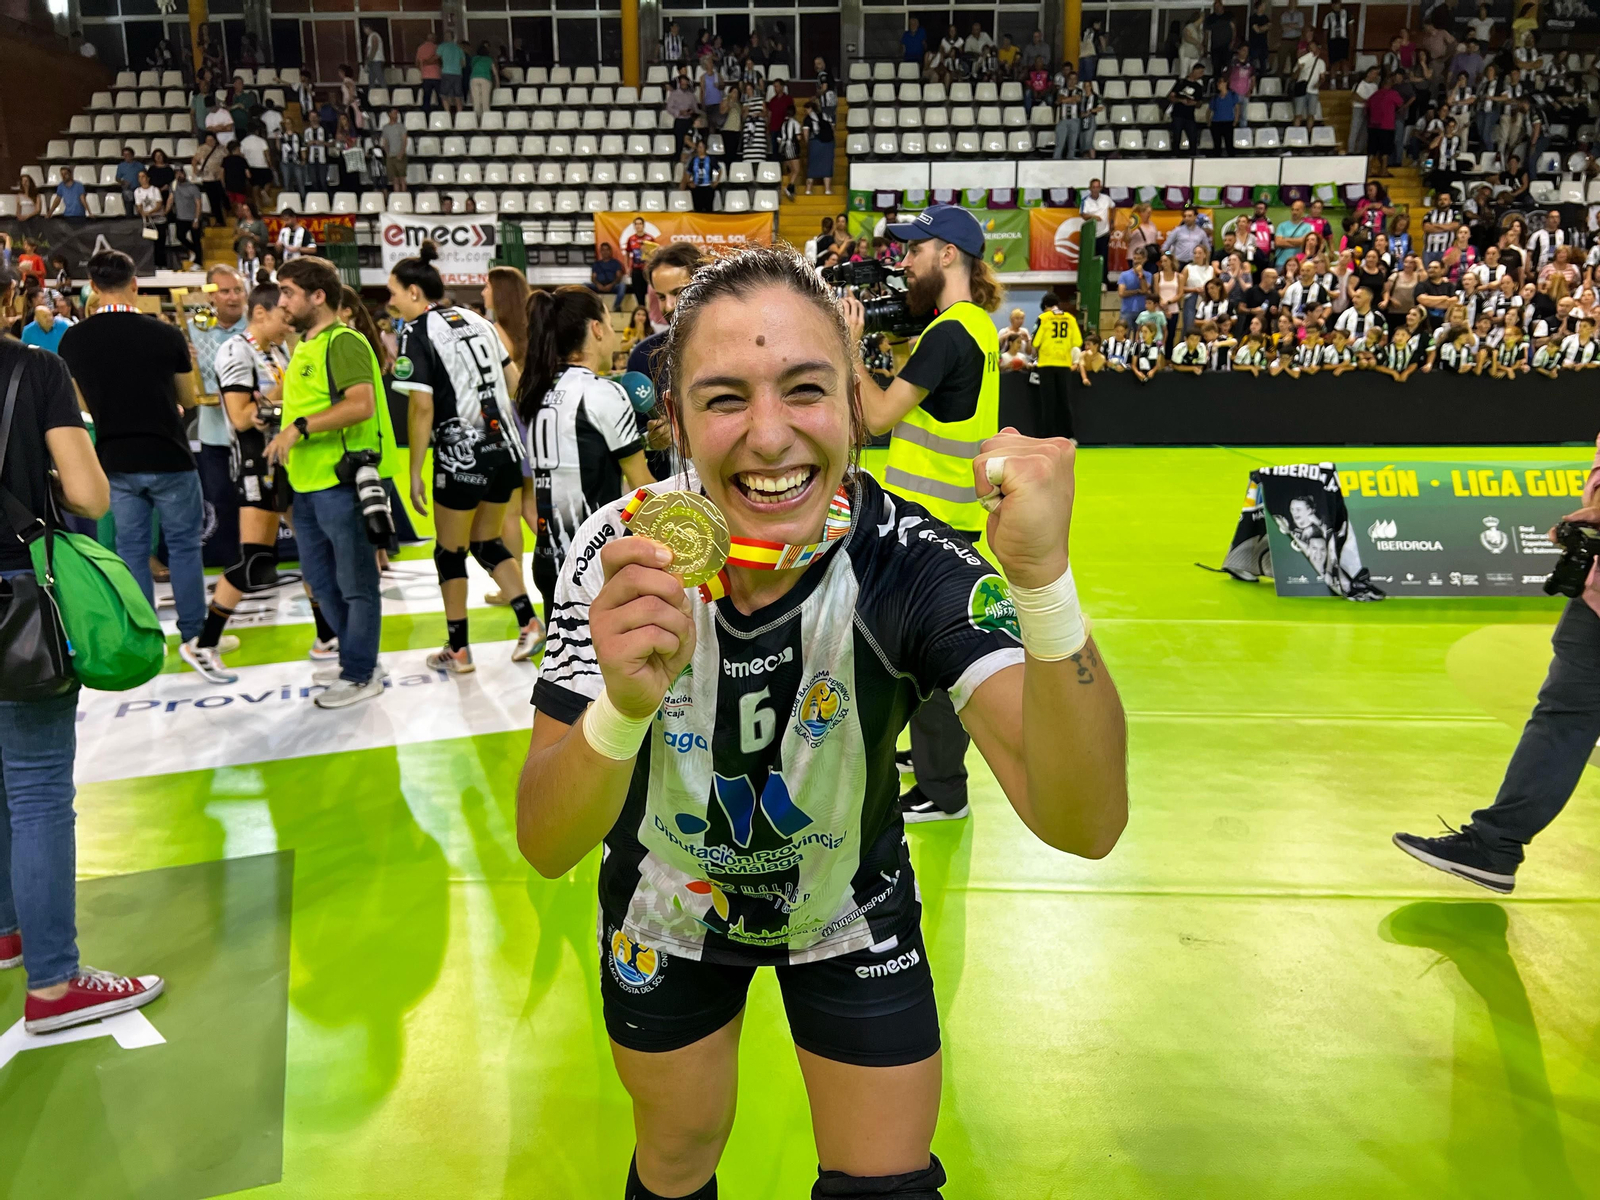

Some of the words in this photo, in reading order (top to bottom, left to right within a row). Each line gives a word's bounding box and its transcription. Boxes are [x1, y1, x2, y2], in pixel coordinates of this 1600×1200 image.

[670, 234, 704, 243] COSTA
[705, 234, 726, 243] DEL
[728, 234, 746, 243] SOL
[1051, 321, 1068, 338] 38
[455, 334, 498, 389] 19
[527, 407, 560, 470] 10
[1338, 465, 1419, 497] PEÓN
[1451, 470, 1523, 497] LIGA
[1377, 540, 1444, 551] IBERDROLA
[723, 654, 782, 678] emec
[115, 668, 449, 717] provinial
[664, 695, 693, 704] dación
[664, 708, 685, 719] icaja
[739, 685, 776, 754] 6
[664, 732, 708, 753] aga
[655, 815, 753, 867] Diputación
[755, 830, 847, 865] Provincial
[729, 854, 804, 874] Málaga
[821, 886, 894, 937] #JugamosPorTi
[855, 956, 911, 979] emec
[619, 981, 640, 994] COSTA
[640, 985, 655, 994] DEL
[652, 974, 665, 987] SOL
